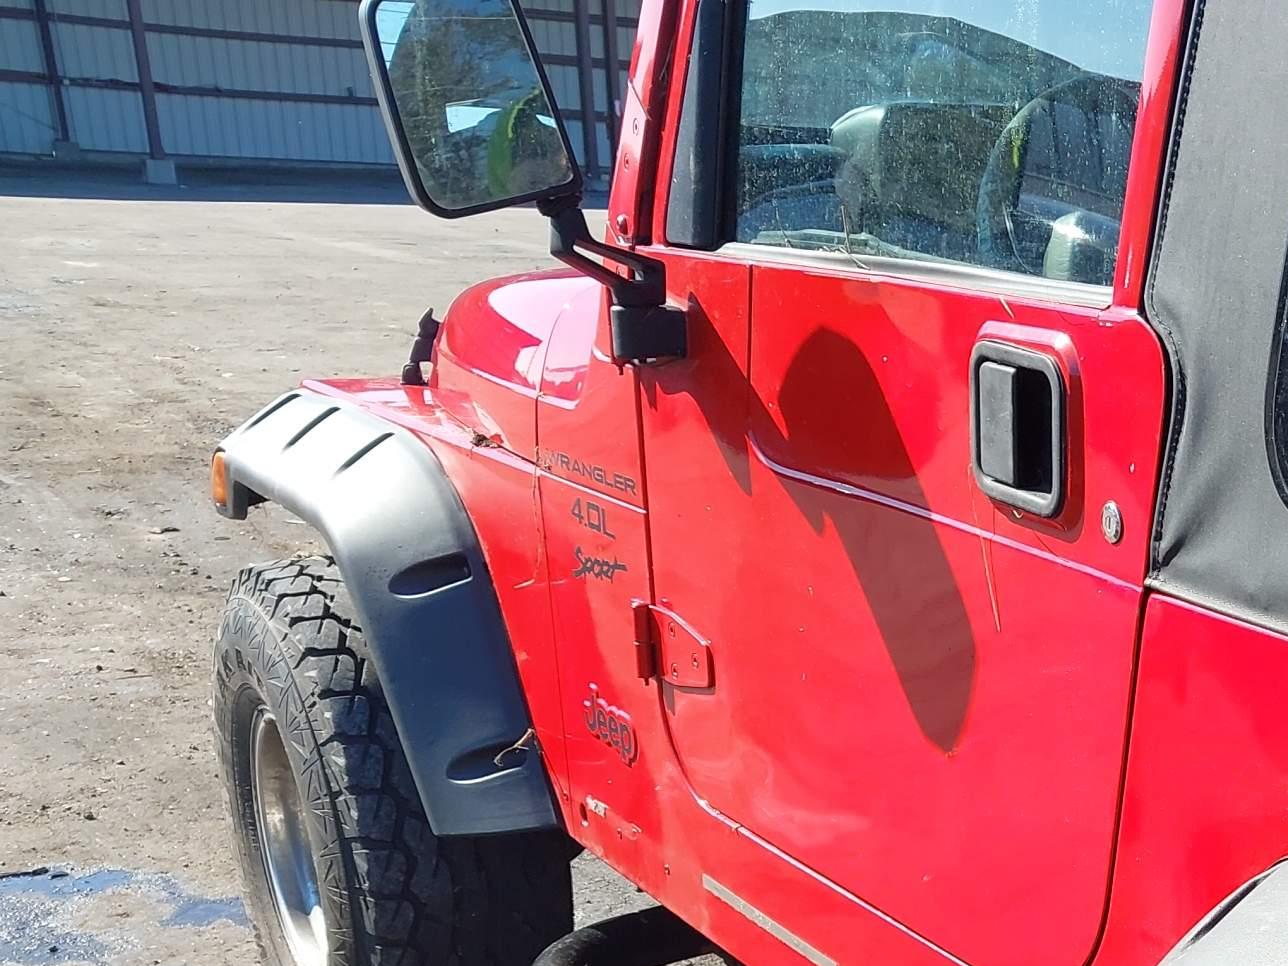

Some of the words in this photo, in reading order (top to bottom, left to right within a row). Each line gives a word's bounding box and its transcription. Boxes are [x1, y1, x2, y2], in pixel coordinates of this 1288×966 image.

[543, 449, 637, 497] WRANGLER
[571, 497, 616, 540] 4.0L
[583, 682, 639, 769] Jeep
